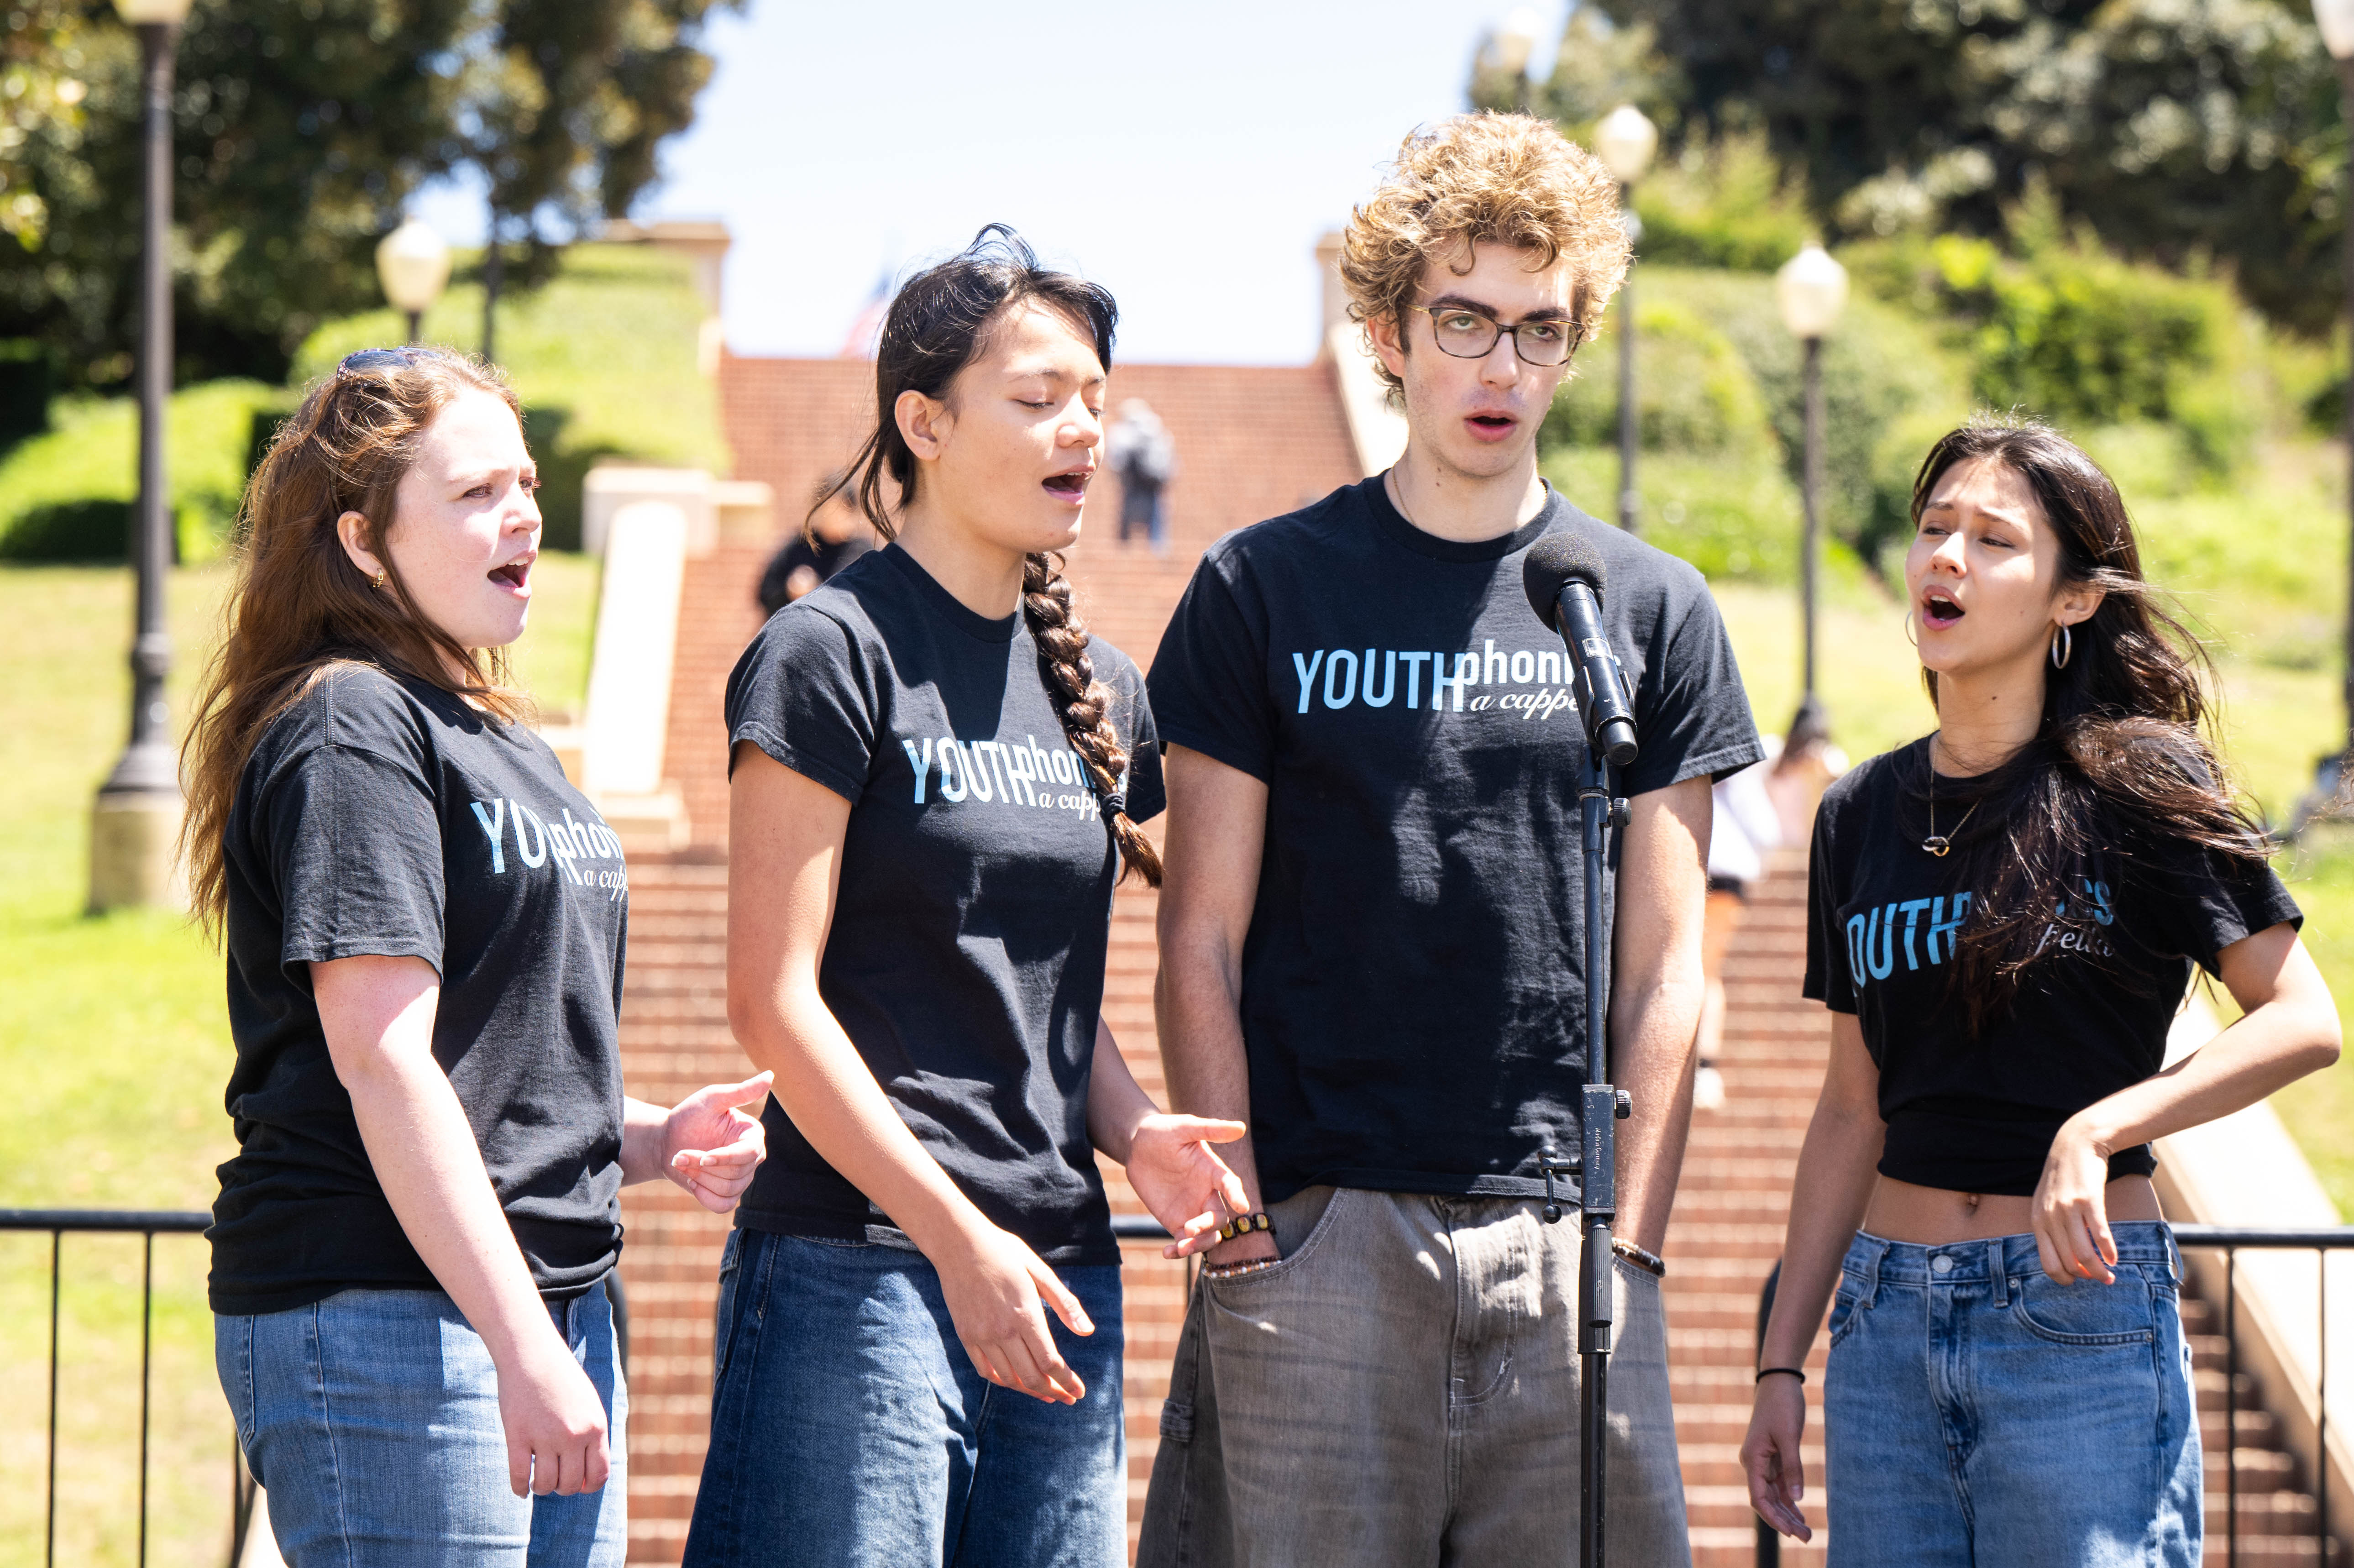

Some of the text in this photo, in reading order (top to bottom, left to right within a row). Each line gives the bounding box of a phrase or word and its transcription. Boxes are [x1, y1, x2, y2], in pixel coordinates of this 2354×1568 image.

[1470, 695, 1496, 712] a
[1038, 792, 1055, 809] a
[584, 870, 597, 887] a
[1594, 1147, 1602, 1169] Germany
